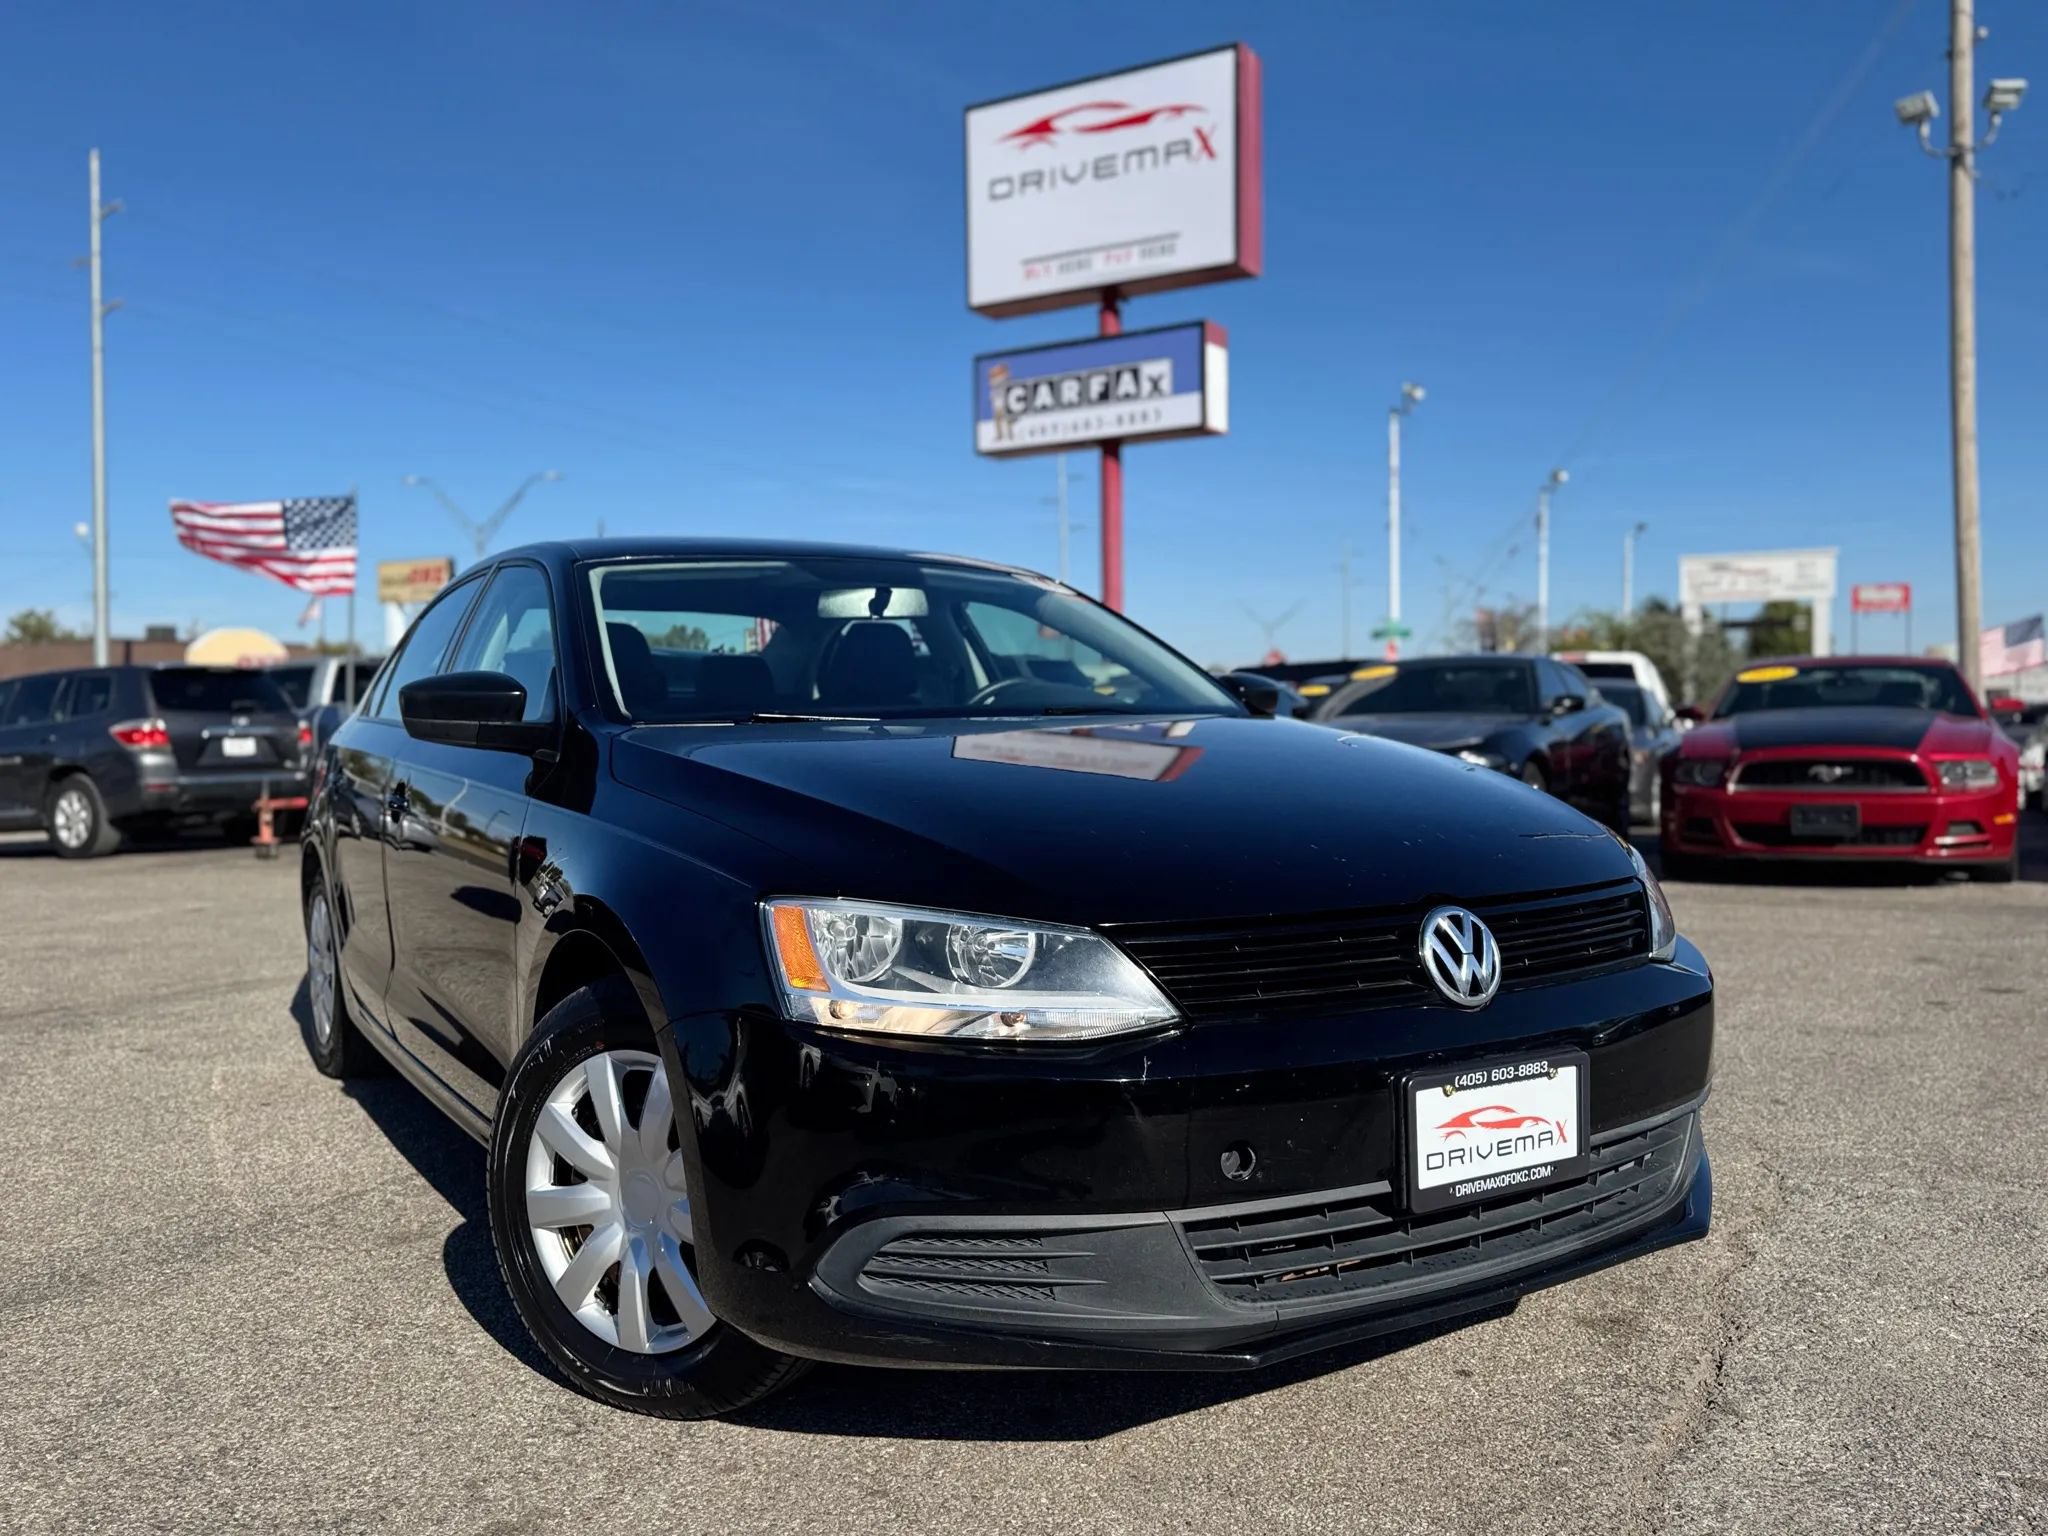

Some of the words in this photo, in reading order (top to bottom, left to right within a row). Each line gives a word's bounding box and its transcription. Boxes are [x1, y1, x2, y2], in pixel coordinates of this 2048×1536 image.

[988, 123, 1217, 201] DRIVEMAX
[1007, 367, 1167, 412] CARFAX
[1455, 1071, 1487, 1088] (405)
[1491, 1061, 1548, 1081] 603-8883
[1427, 1119, 1567, 1171] DRIVEMAX
[1455, 1166, 1551, 1197] DRIVEMAXOFOKC.COM
